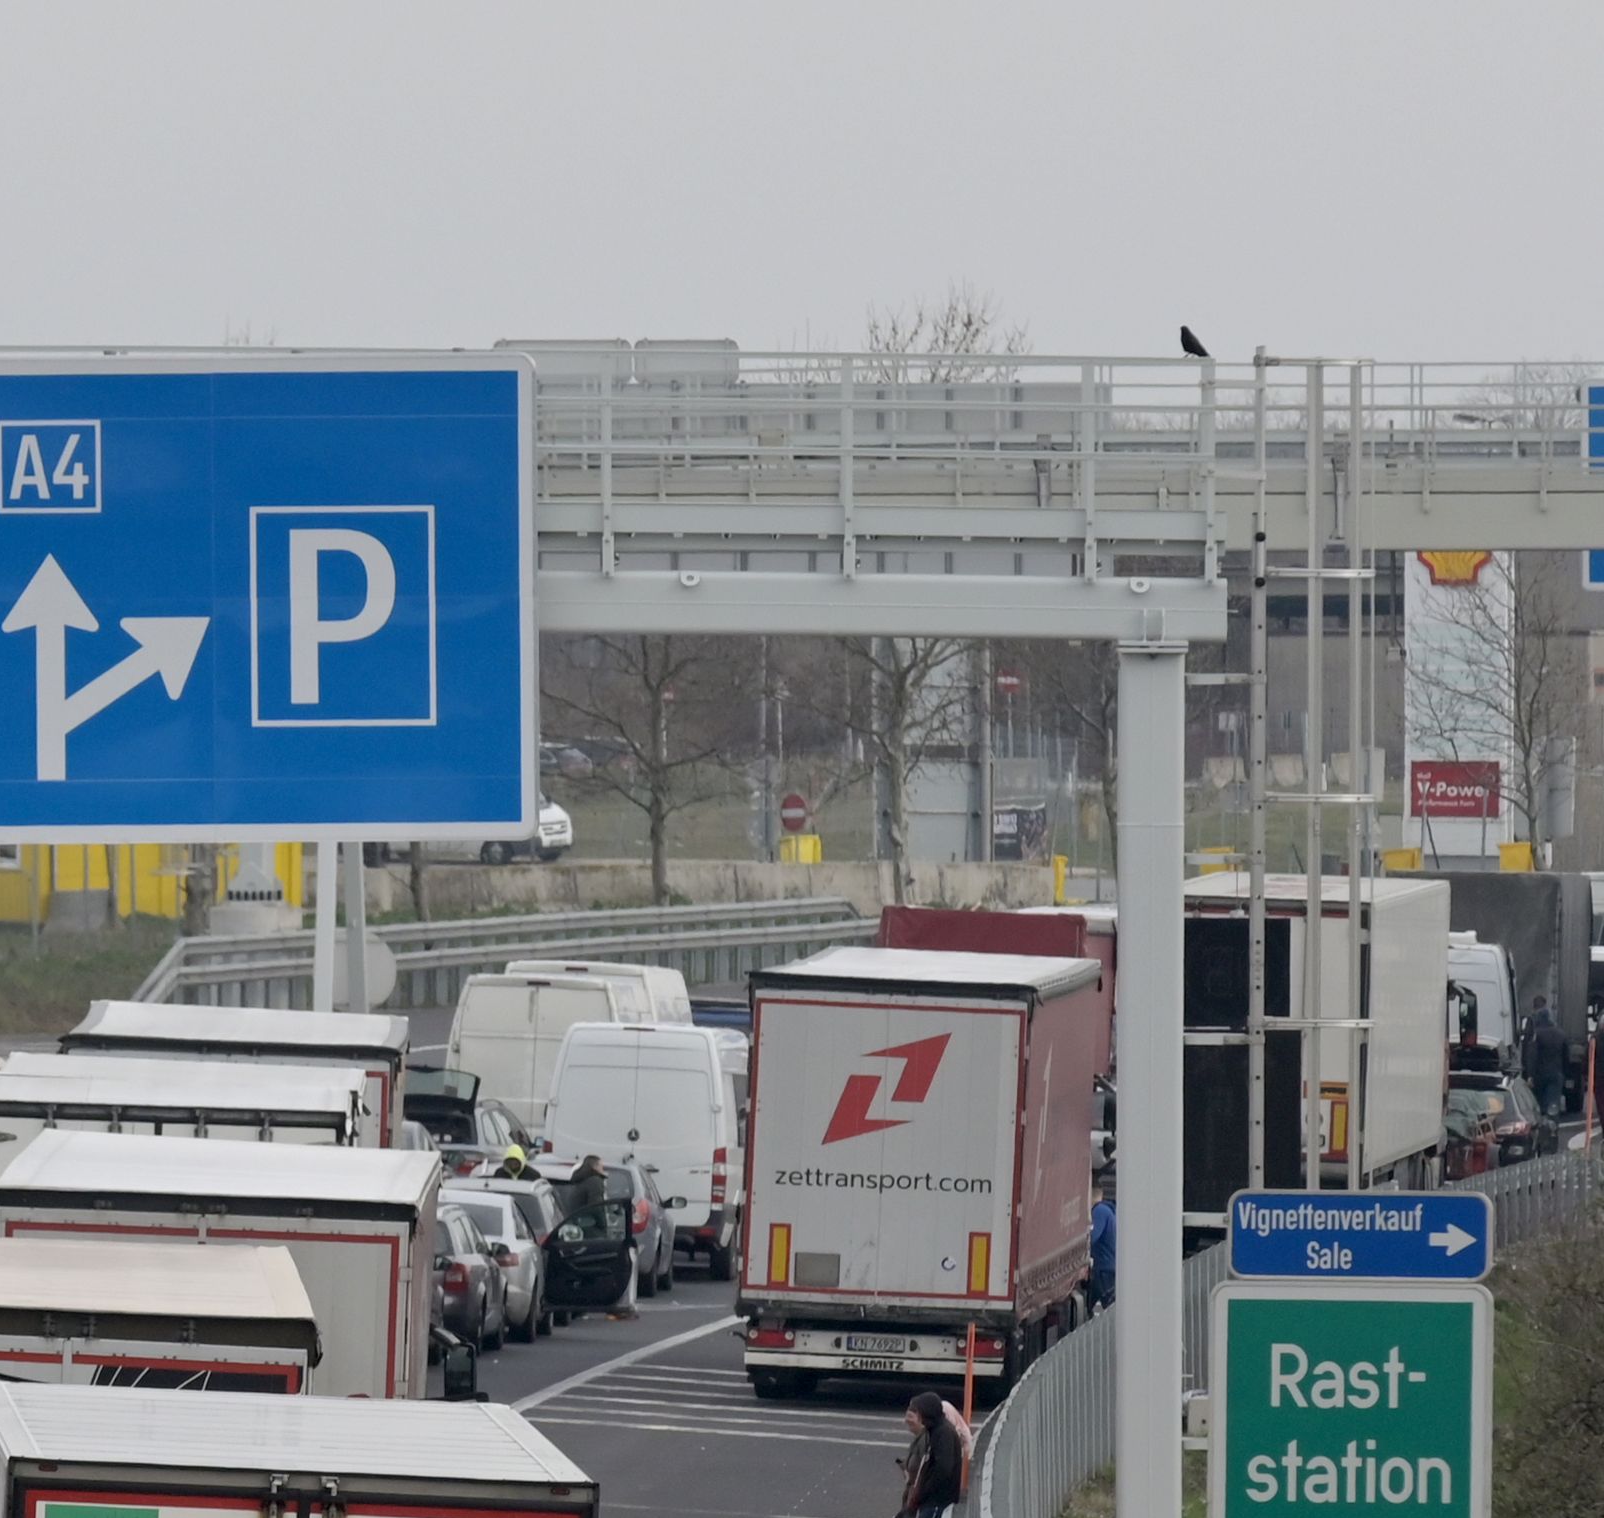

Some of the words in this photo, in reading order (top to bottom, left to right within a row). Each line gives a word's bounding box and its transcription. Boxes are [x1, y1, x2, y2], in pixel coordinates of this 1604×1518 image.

[9, 433, 90, 500] A4
[289, 528, 397, 705] P
[775, 1167, 993, 1195] zettransport.com
[1238, 1202, 1424, 1237] Vignettenverkauf
[1305, 1242, 1353, 1270] Sale
[842, 1358, 905, 1371] SCHMITZ
[1269, 1342, 1427, 1409] Rast-
[1245, 1439, 1452, 1504] station
